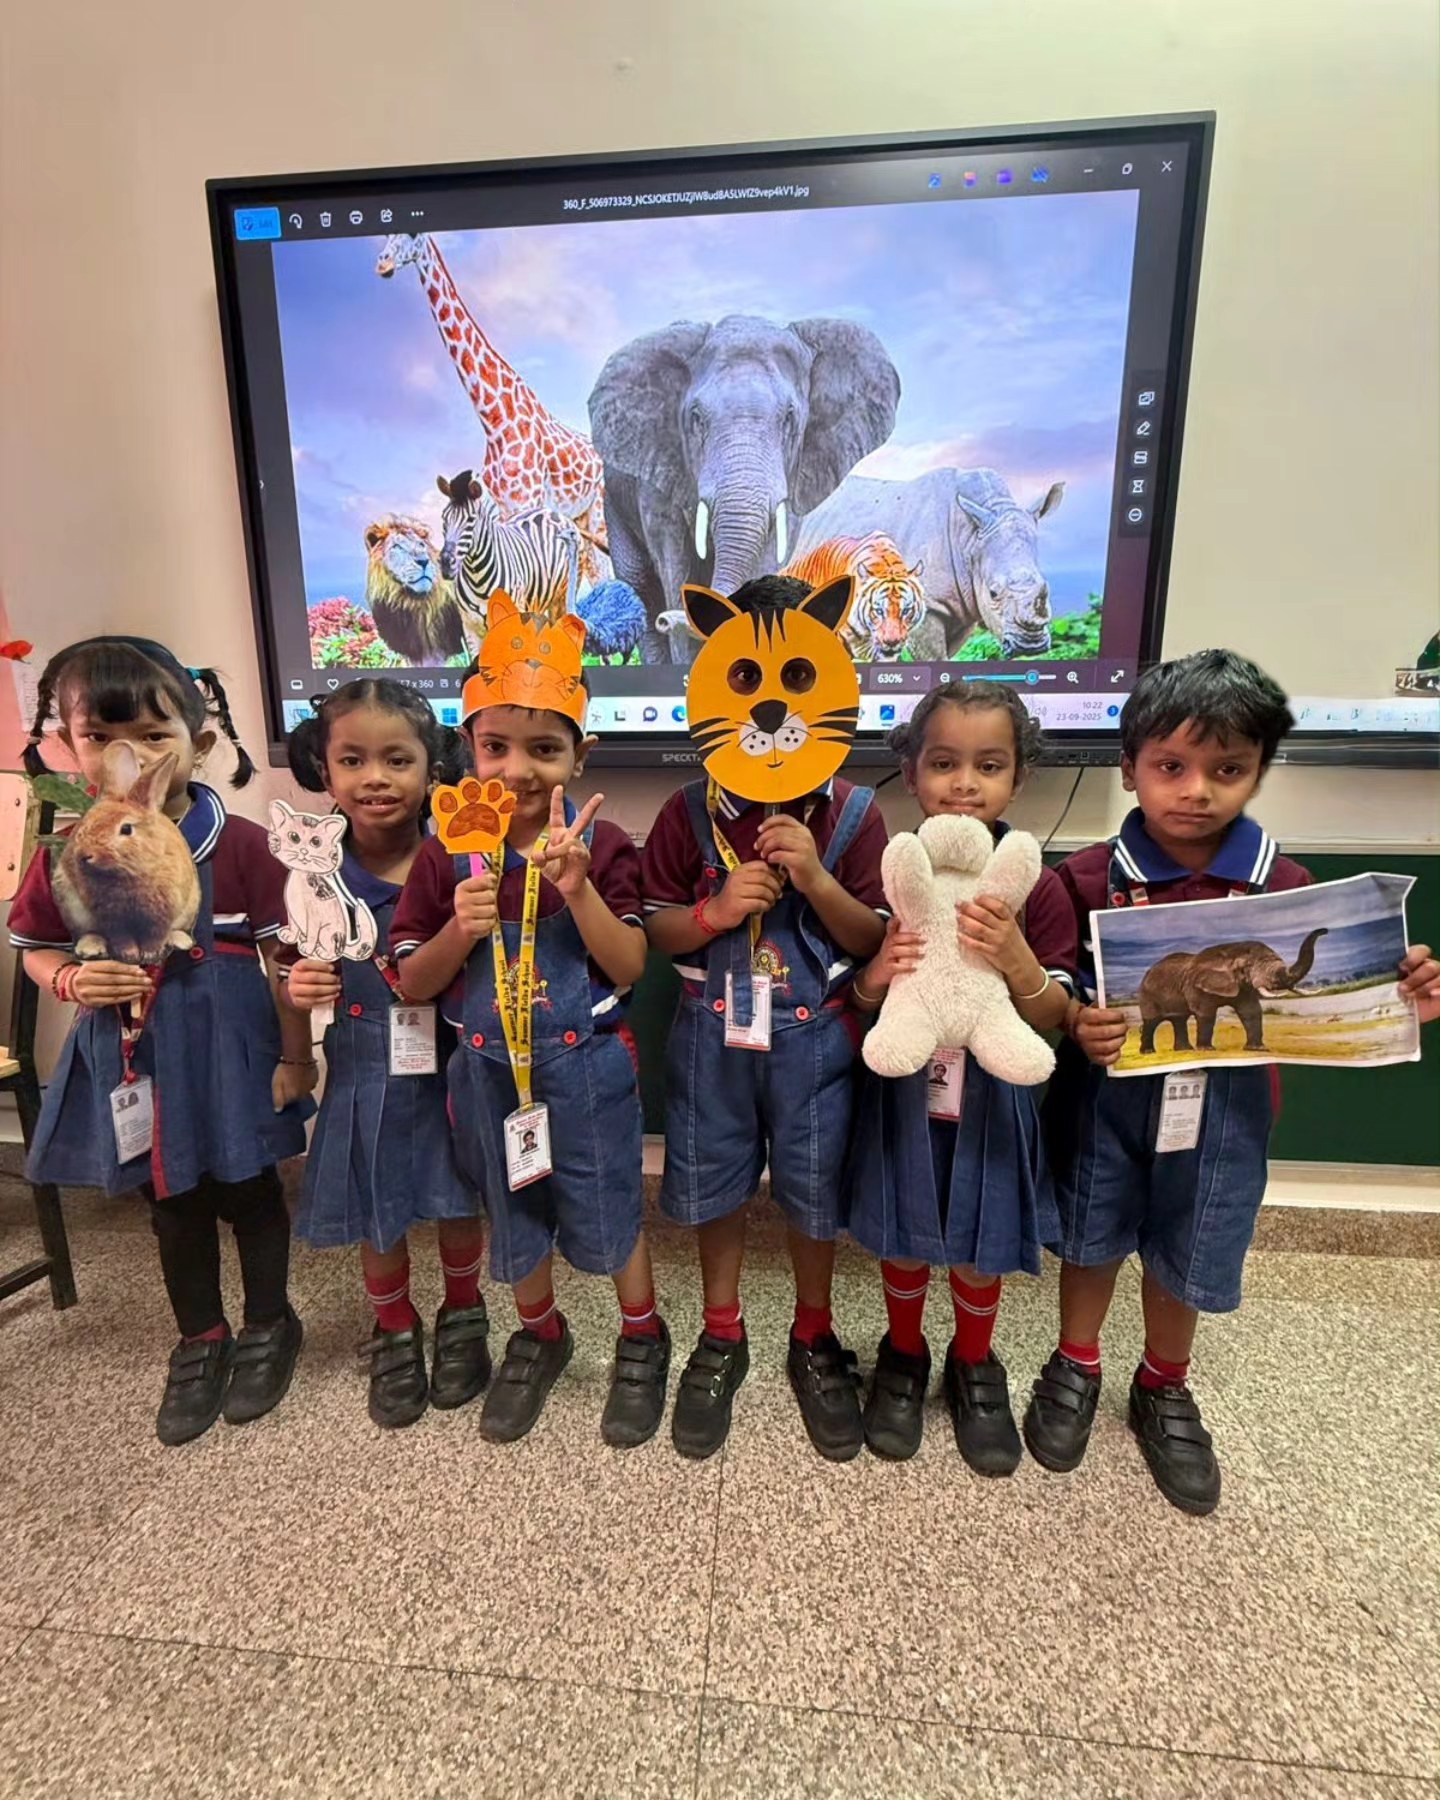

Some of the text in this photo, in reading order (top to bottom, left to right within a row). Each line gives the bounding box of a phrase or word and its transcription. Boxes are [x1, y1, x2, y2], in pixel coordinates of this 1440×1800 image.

[419, 679, 434, 688] 360
[877, 673, 903, 684] 630%
[1056, 713, 1103, 721] 23-09-2025
[521, 961, 531, 1046] Summer Fields School
